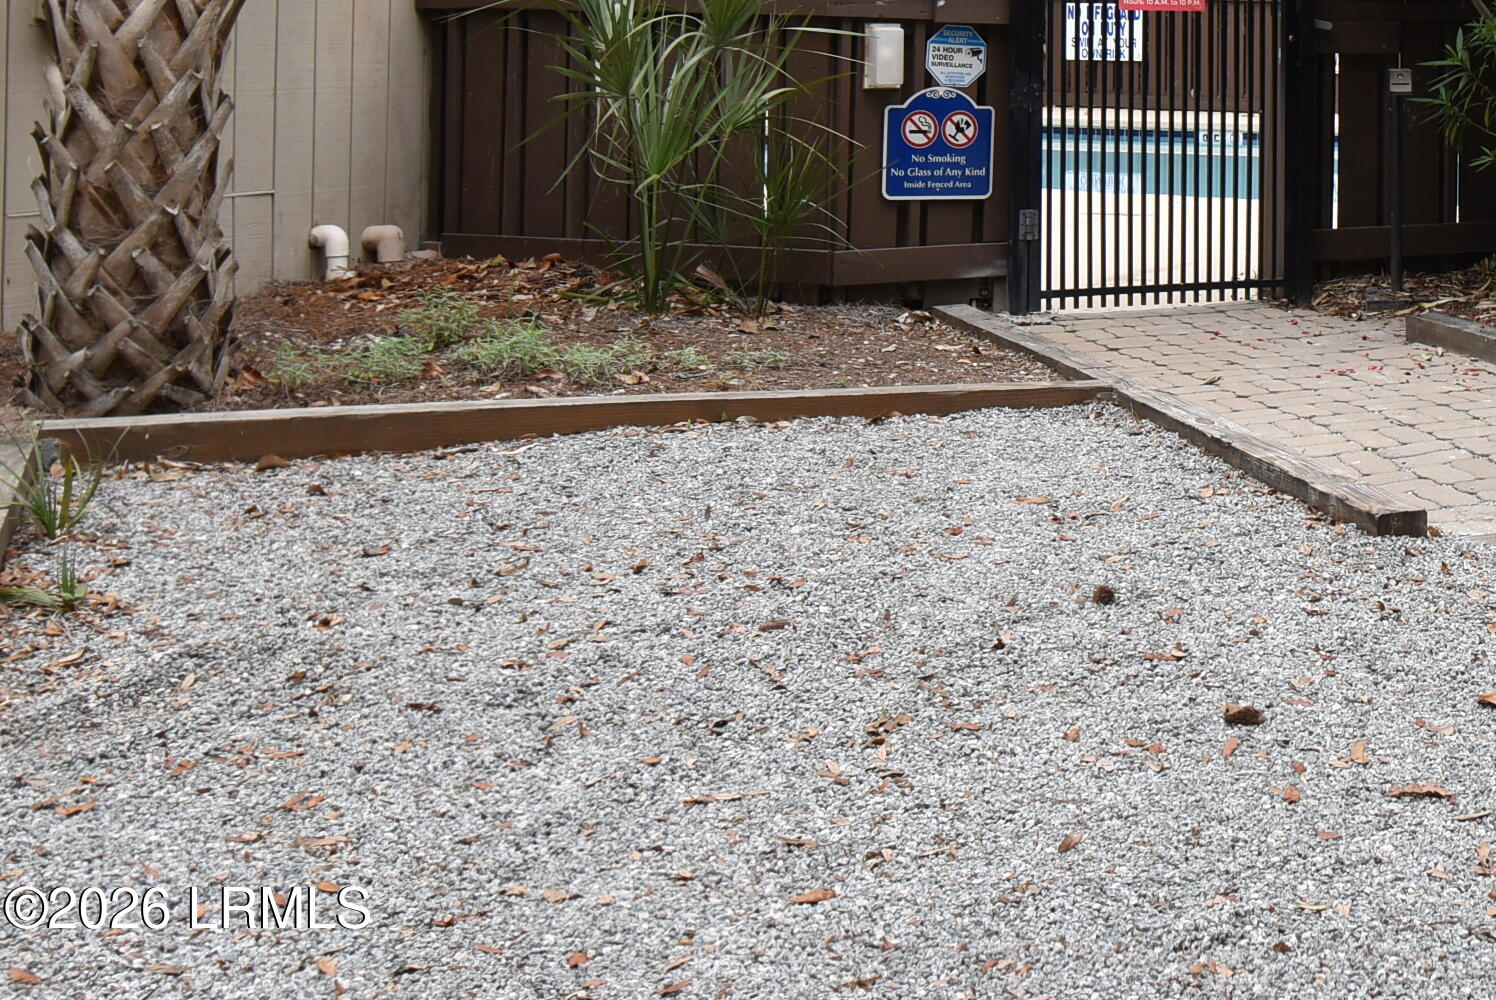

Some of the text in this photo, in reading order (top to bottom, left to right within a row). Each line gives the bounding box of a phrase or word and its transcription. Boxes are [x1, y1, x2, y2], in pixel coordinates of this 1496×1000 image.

[1105, 49, 1126, 59] RIK
[931, 61, 974, 69] SURVEILLANCE
[911, 153, 966, 165] No Smoking
[890, 167, 986, 179] No Glass of Any Kind
